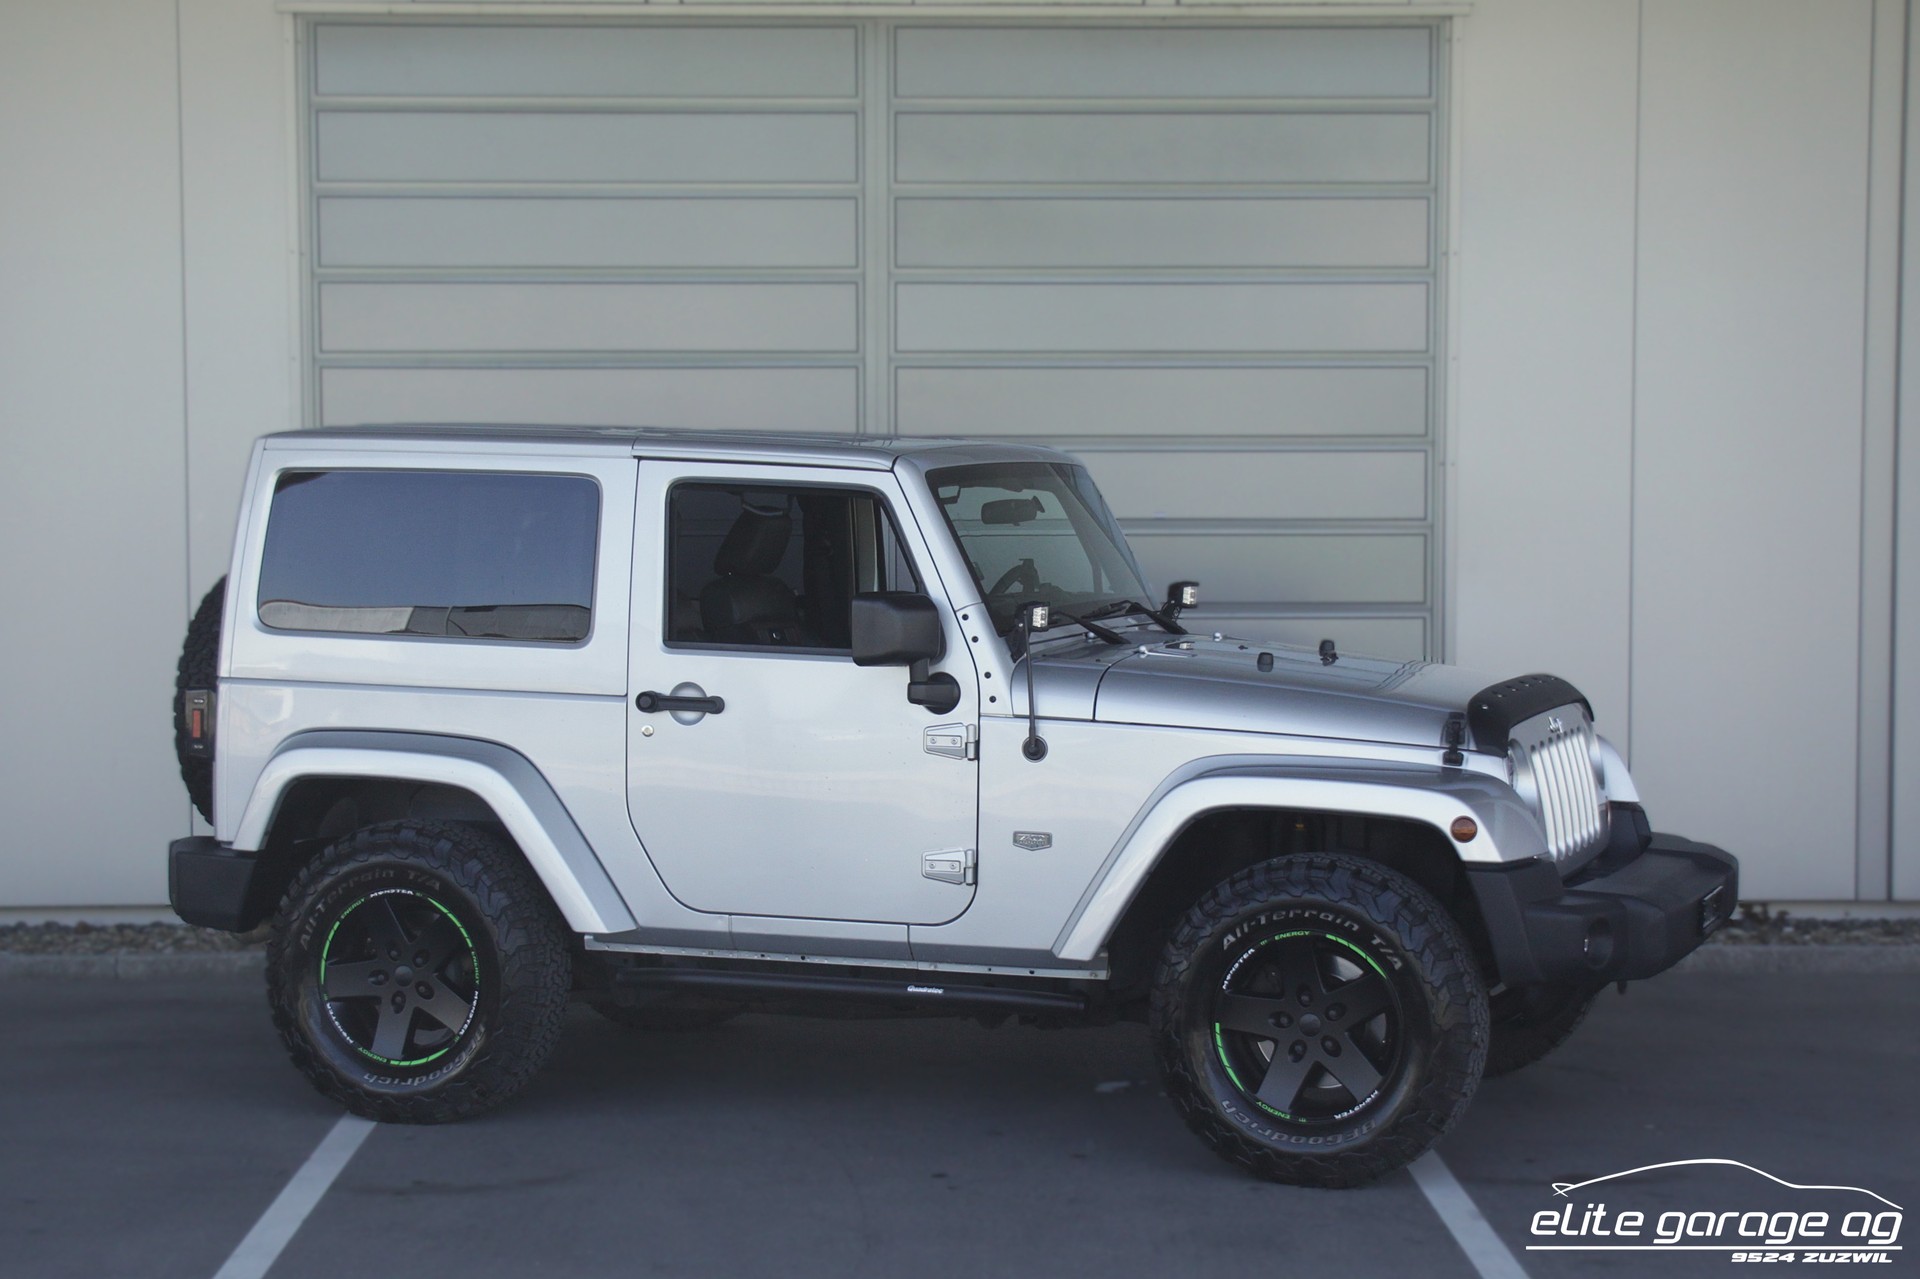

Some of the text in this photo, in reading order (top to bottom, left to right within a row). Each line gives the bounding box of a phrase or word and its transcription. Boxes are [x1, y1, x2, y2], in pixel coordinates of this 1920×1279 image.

[369, 888, 414, 898] MONSTER
[301, 868, 441, 951] All-Terrain T/A
[1223, 909, 1403, 971] All-Terrain T/A
[1274, 930, 1310, 941] ENERGY
[357, 1047, 388, 1063] ENERGY
[1256, 1090, 1380, 1120] MONSTER ENERGY
[1221, 1100, 1377, 1146] BFGoodrich
